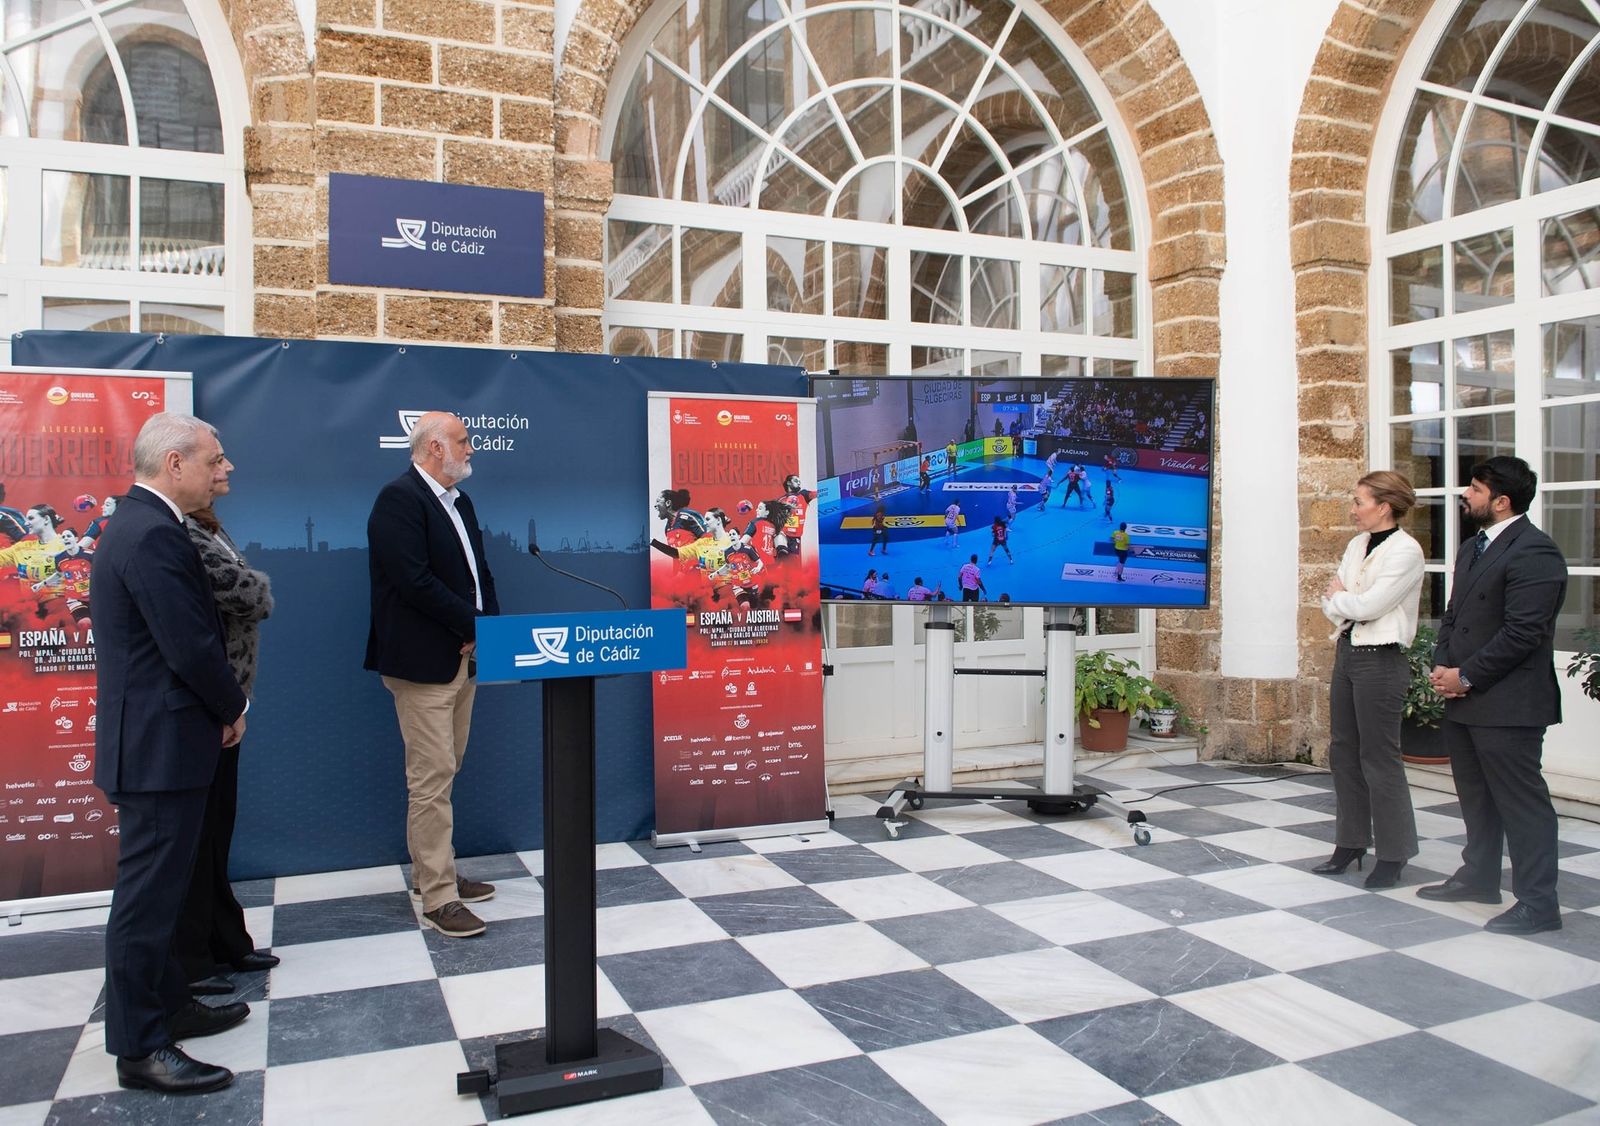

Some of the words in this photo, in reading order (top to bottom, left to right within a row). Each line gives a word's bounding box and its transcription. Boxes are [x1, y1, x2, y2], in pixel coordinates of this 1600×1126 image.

[431, 221, 497, 239] Diputación
[431, 239, 447, 252] de
[451, 240, 485, 255] Cádiz
[924, 381, 951, 394] CIUDAD
[924, 391, 962, 405] ALGECIRAS
[980, 393, 991, 402] ESP
[454, 411, 529, 430] iputación
[41, 425, 105, 434] ALGECIRAS
[471, 434, 515, 451] Cádiz
[0, 432, 136, 480] UERRERA
[1058, 448, 1089, 456] RACIANO
[674, 449, 796, 485] GUERRERAS
[1160, 456, 1195, 471] Viñedos
[1131, 525, 1207, 537] sac
[700, 609, 733, 626] ESPAÑA
[746, 609, 781, 624] AUSTRIA
[19, 627, 67, 648] ESPAÑA
[575, 623, 654, 644] Diputación
[48, 656, 66, 664] JUAN
[576, 648, 595, 664] de
[600, 645, 640, 662] Cádiz
[35, 665, 58, 673] SÁBADO
[5, 780, 35, 790] helvetia
[36, 797, 57, 805] AVIS
[67, 794, 95, 806] renfe
[577, 1069, 598, 1077] MARK
